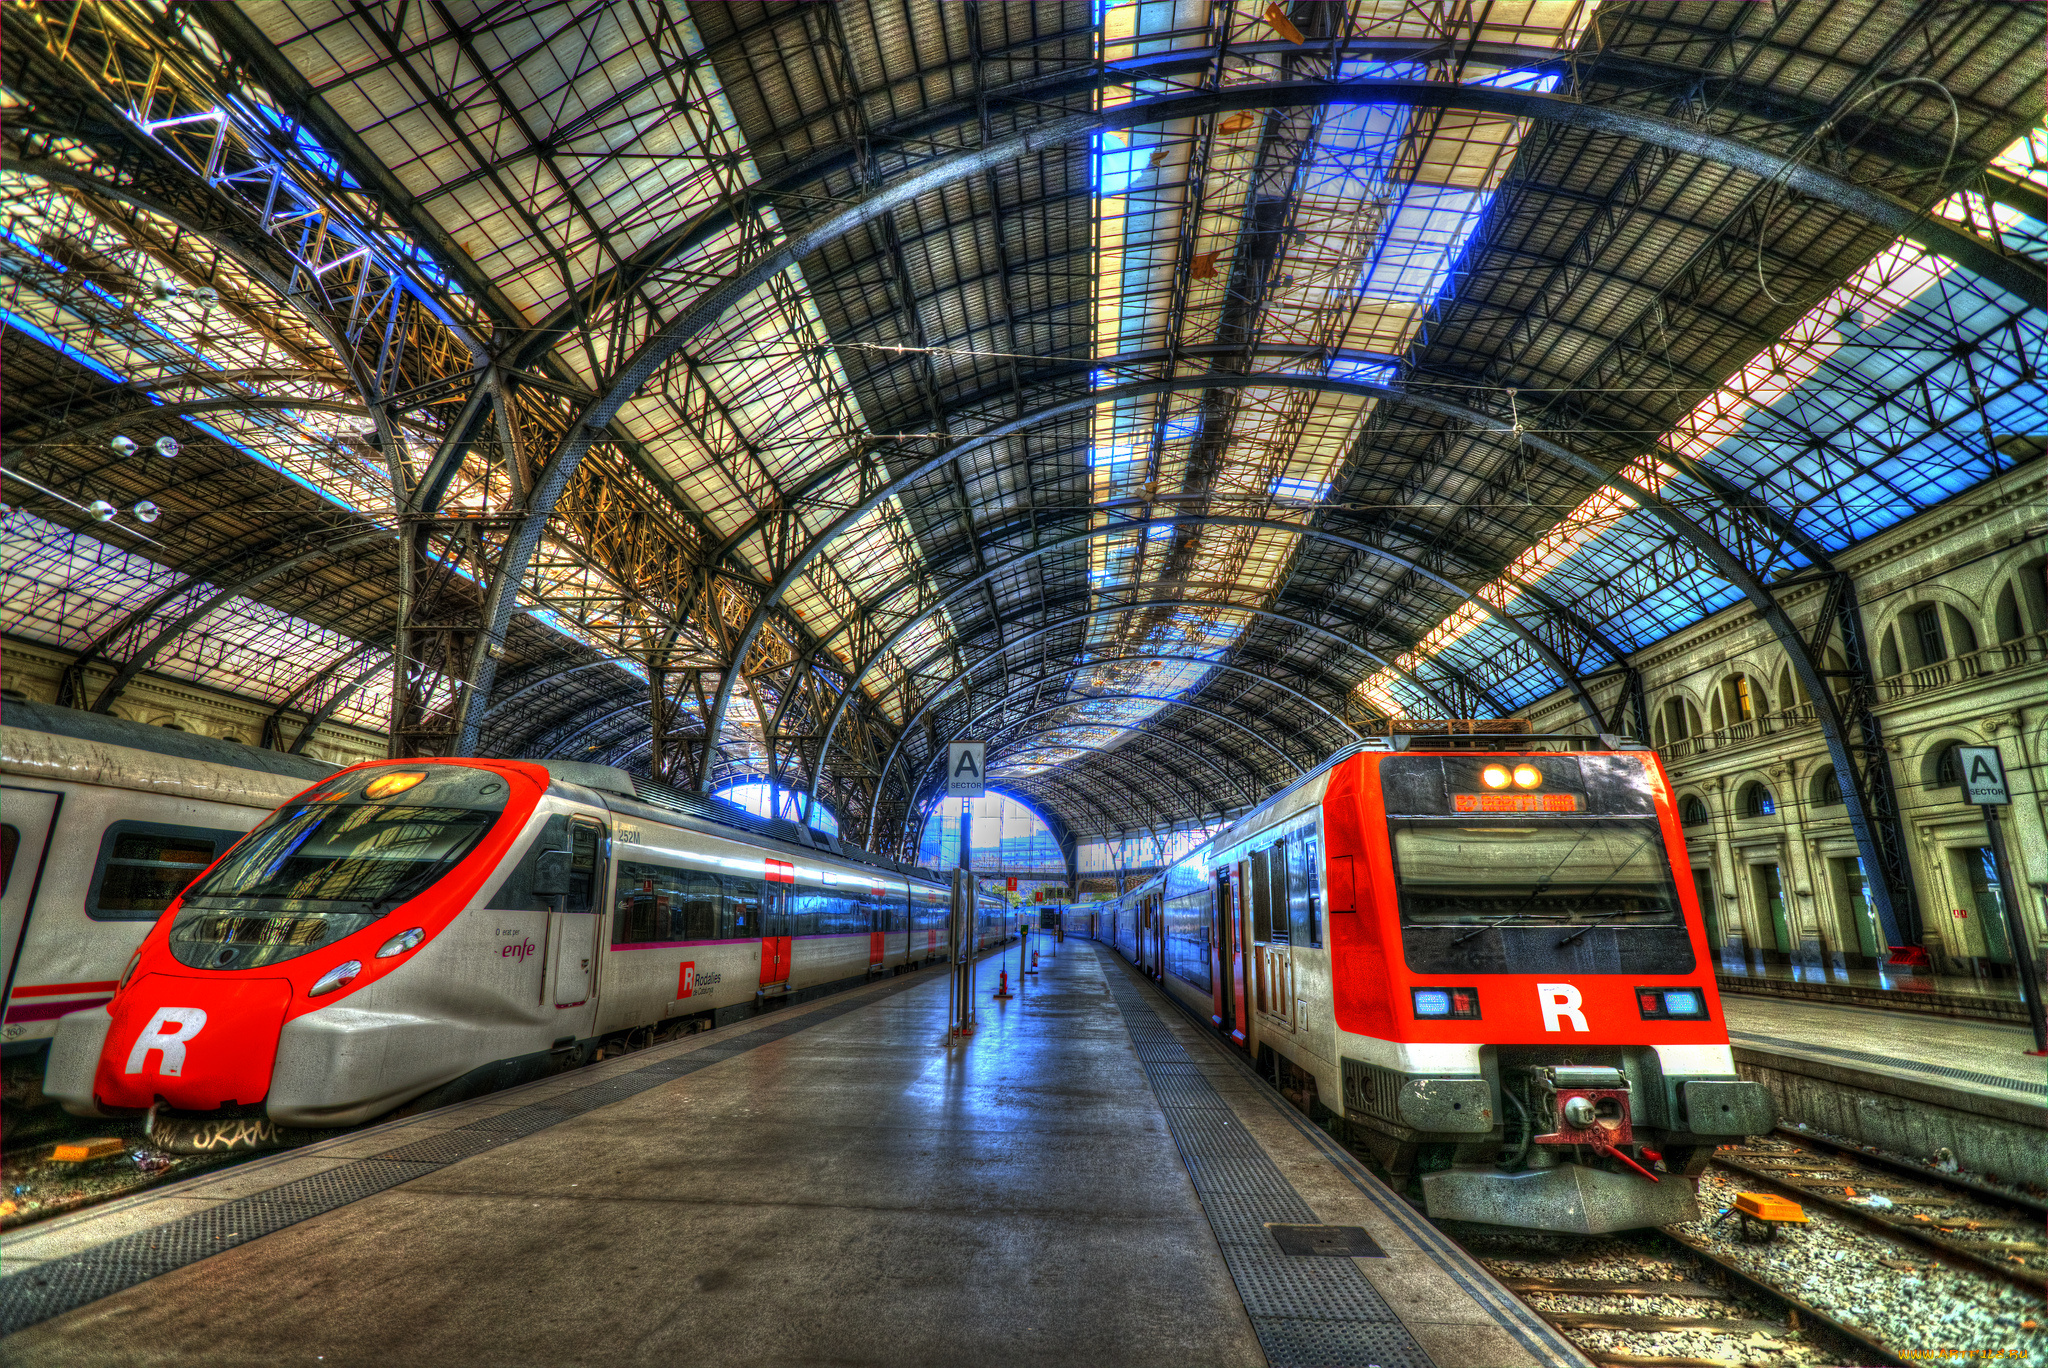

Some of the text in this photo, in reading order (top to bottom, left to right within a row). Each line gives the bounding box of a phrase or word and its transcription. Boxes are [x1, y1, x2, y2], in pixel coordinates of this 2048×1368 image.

[954, 750, 979, 778] A
[1970, 755, 1998, 784] A
[618, 829, 640, 844] 252M
[684, 968, 694, 991] R
[694, 971, 722, 986] Rodalies
[1537, 983, 1590, 1032] R
[125, 1007, 207, 1077] R
